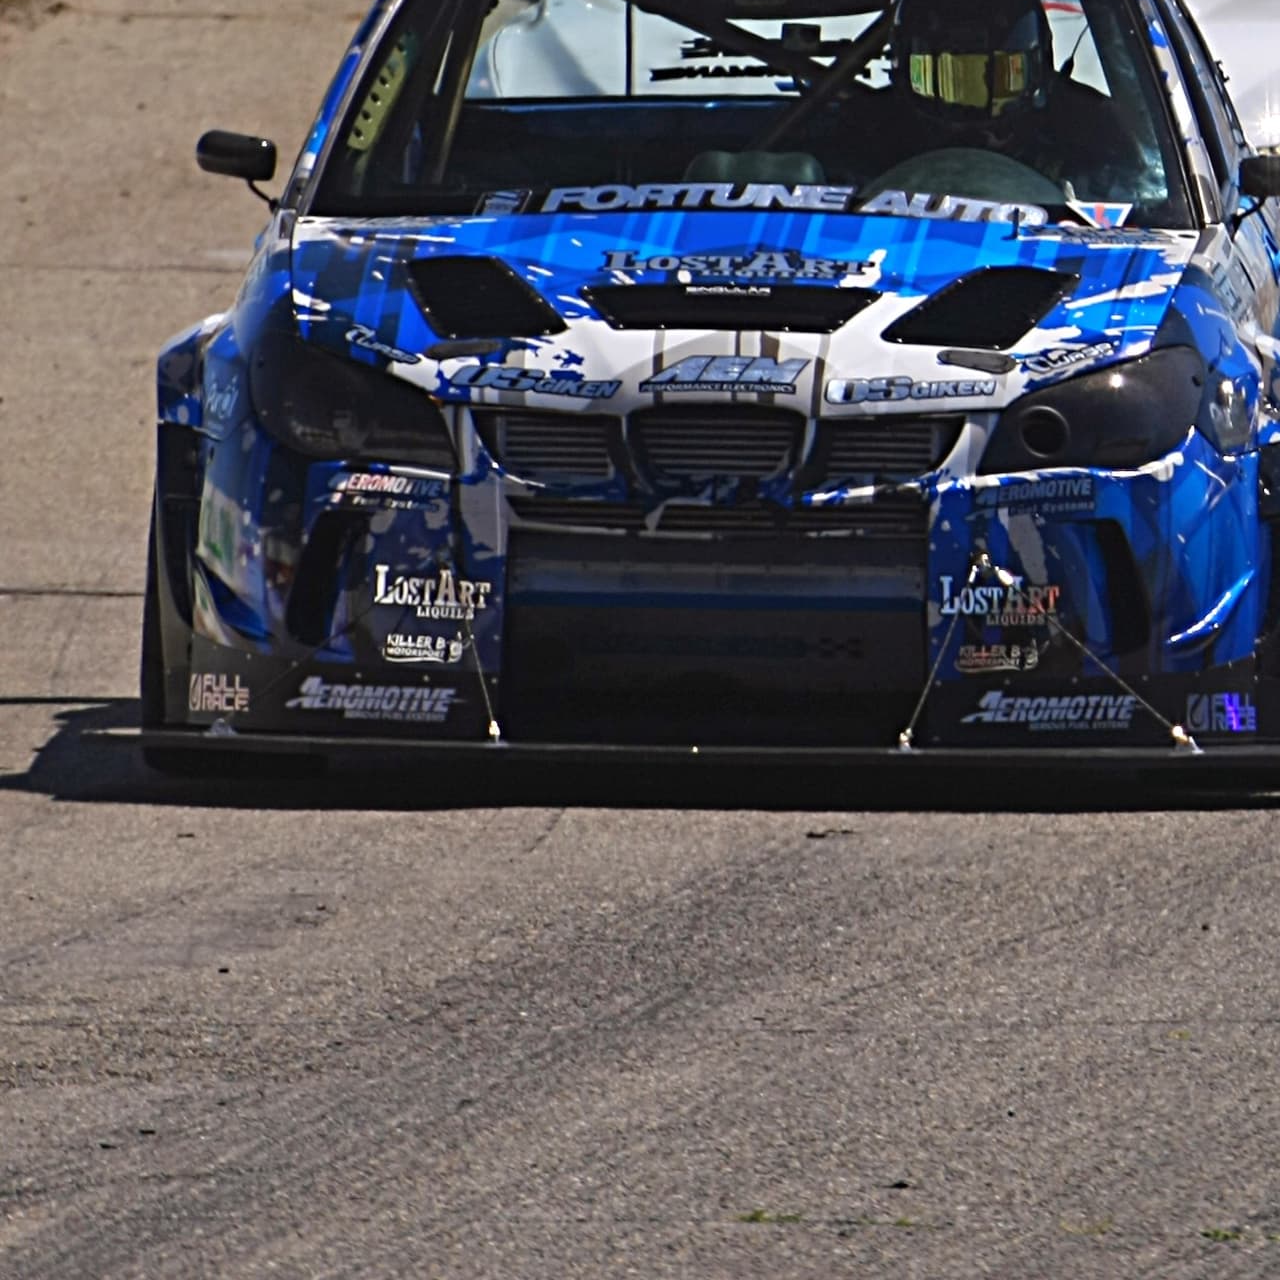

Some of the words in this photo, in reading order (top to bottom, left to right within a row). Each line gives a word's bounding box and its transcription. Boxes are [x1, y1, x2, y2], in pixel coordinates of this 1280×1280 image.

[540, 183, 853, 212] FORTUNE
[859, 189, 1048, 227] AUTO
[649, 355, 811, 383] AEM
[642, 383, 718, 393] PERFORMANCE
[721, 384, 794, 394] ELECTRONICS
[387, 634, 432, 649] KILLER
[435, 636, 446, 650] B
[202, 674, 248, 691] FULL
[286, 676, 456, 712] AEROMOTIVE
[202, 692, 249, 711] RACE
[961, 691, 1138, 723] AEROMOTIVE
